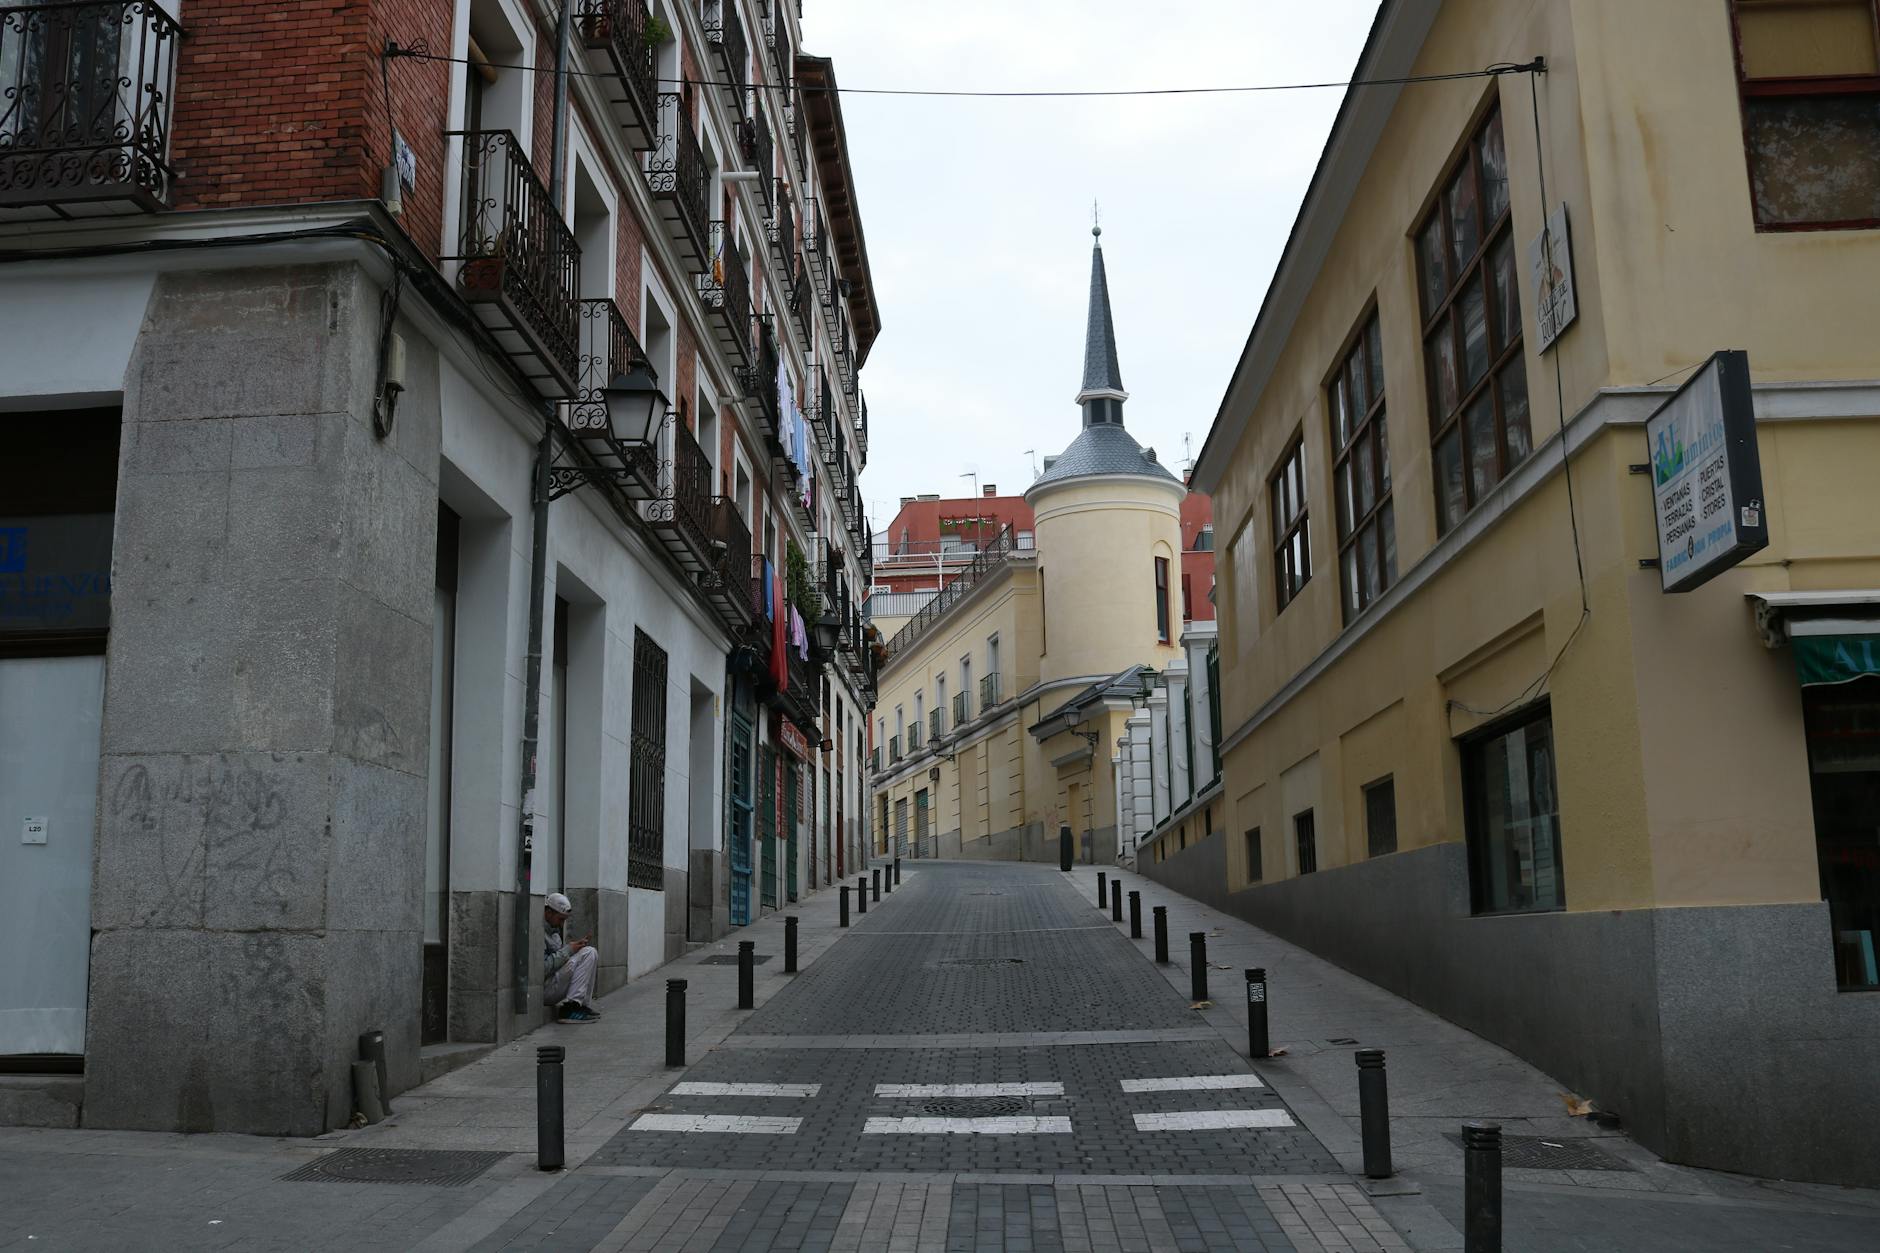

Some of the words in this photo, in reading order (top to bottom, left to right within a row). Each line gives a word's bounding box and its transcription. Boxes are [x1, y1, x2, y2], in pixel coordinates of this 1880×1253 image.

[1700, 454, 1725, 485] PUERTAS
[1662, 482, 1691, 510] VENTANAS
[1701, 477, 1725, 503] CRISTAL
[1664, 499, 1693, 529] TERRAZAS
[1703, 494, 1726, 520] STORES
[1666, 515, 1696, 545] PERSIANAS
